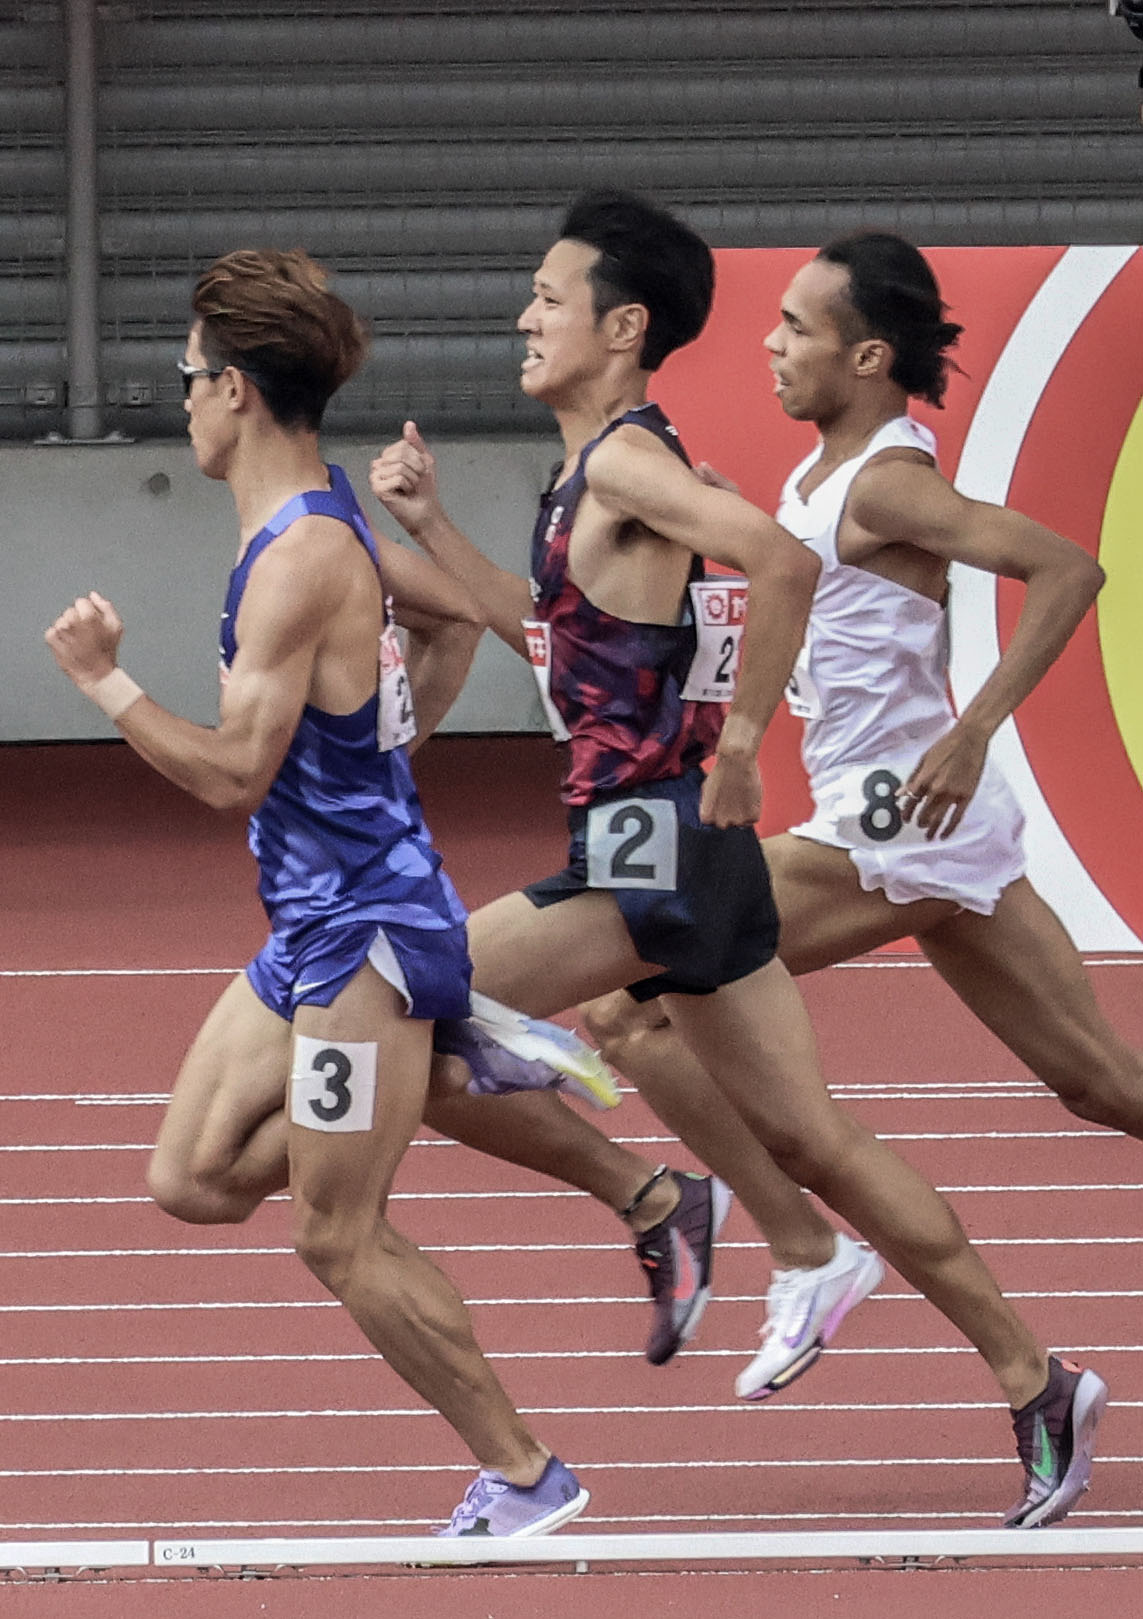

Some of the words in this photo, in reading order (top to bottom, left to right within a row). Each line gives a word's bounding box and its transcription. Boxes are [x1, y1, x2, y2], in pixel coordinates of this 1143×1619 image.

[714, 636, 734, 682] 2
[861, 769, 903, 841] 8
[608, 804, 656, 879] 2
[308, 1048, 351, 1122] 3
[163, 1547, 195, 1561] C-24
